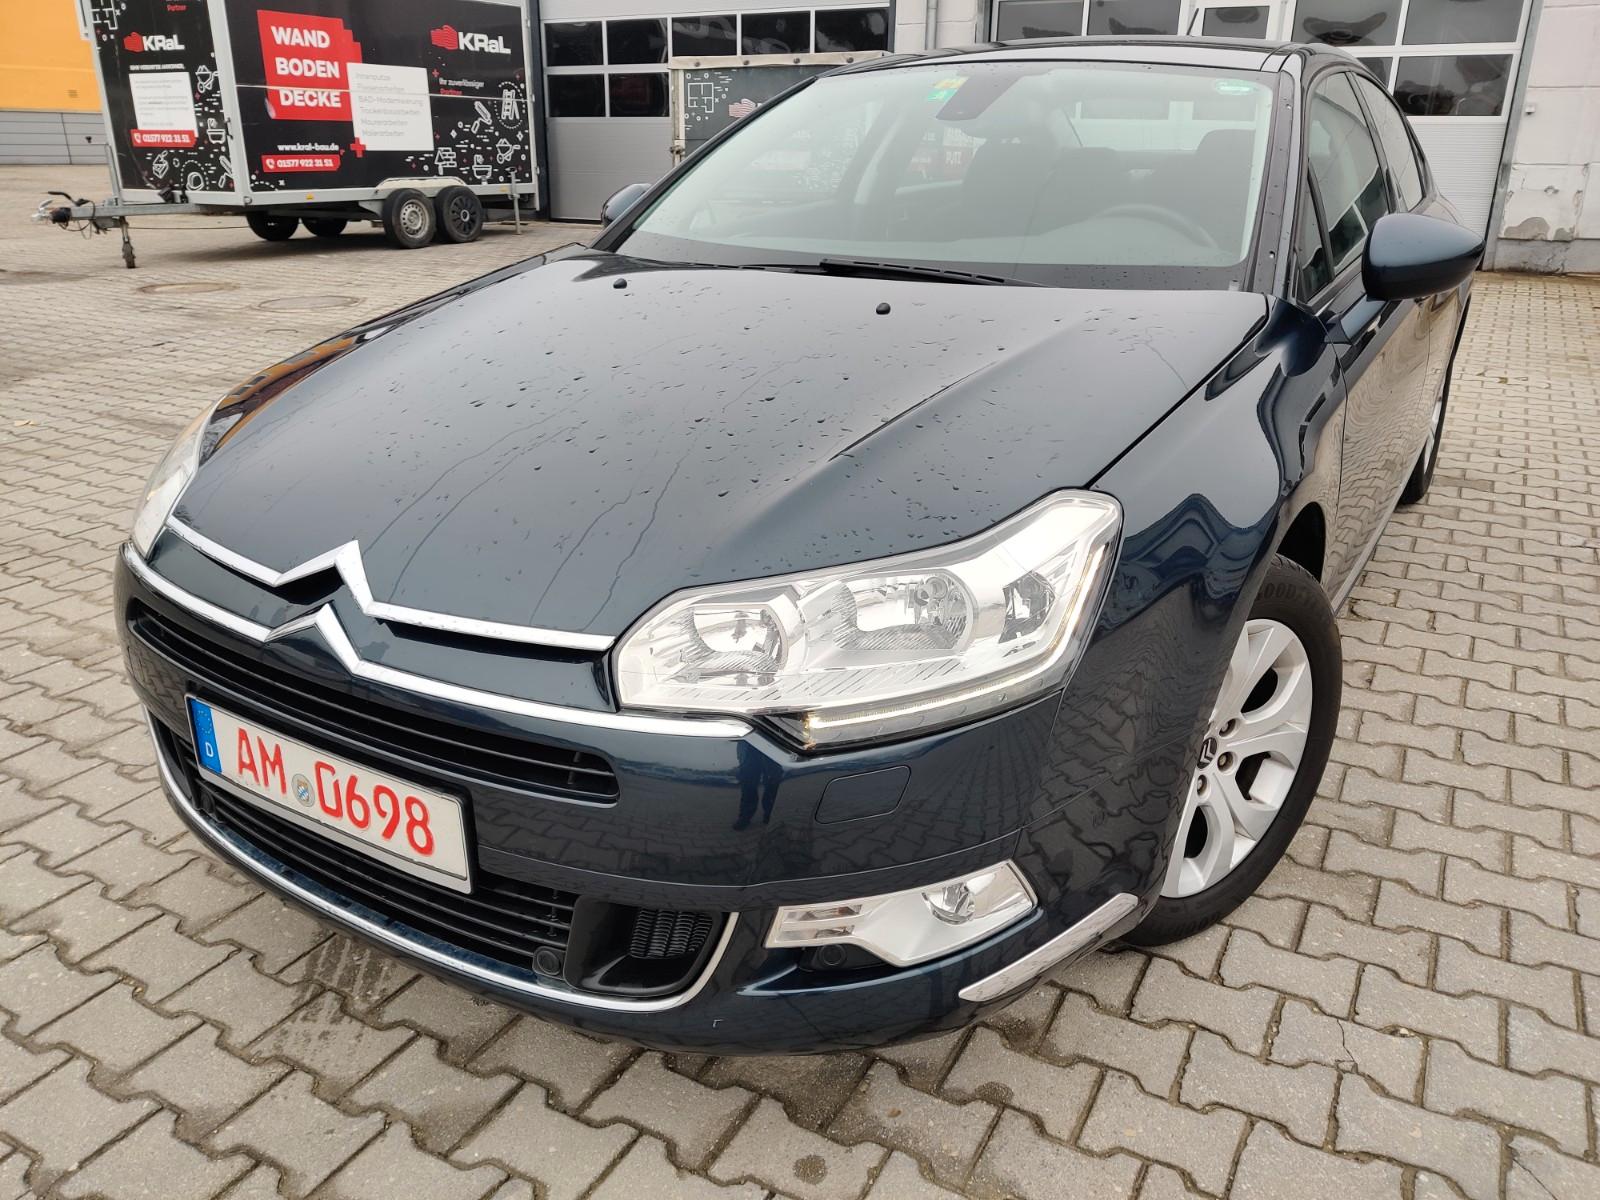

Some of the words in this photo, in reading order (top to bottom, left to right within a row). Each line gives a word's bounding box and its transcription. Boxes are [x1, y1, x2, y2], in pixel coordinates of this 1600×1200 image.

[270, 25, 331, 49] WAND
[275, 57, 341, 79] BODEN
[279, 89, 342, 108] DECKE
[277, 142, 340, 151] www.kral-bau.de
[276, 159, 299, 168] 01577
[299, 158, 314, 167] 922
[205, 742, 214, 757] D
[238, 728, 287, 795] AM
[314, 761, 435, 856] 0698
